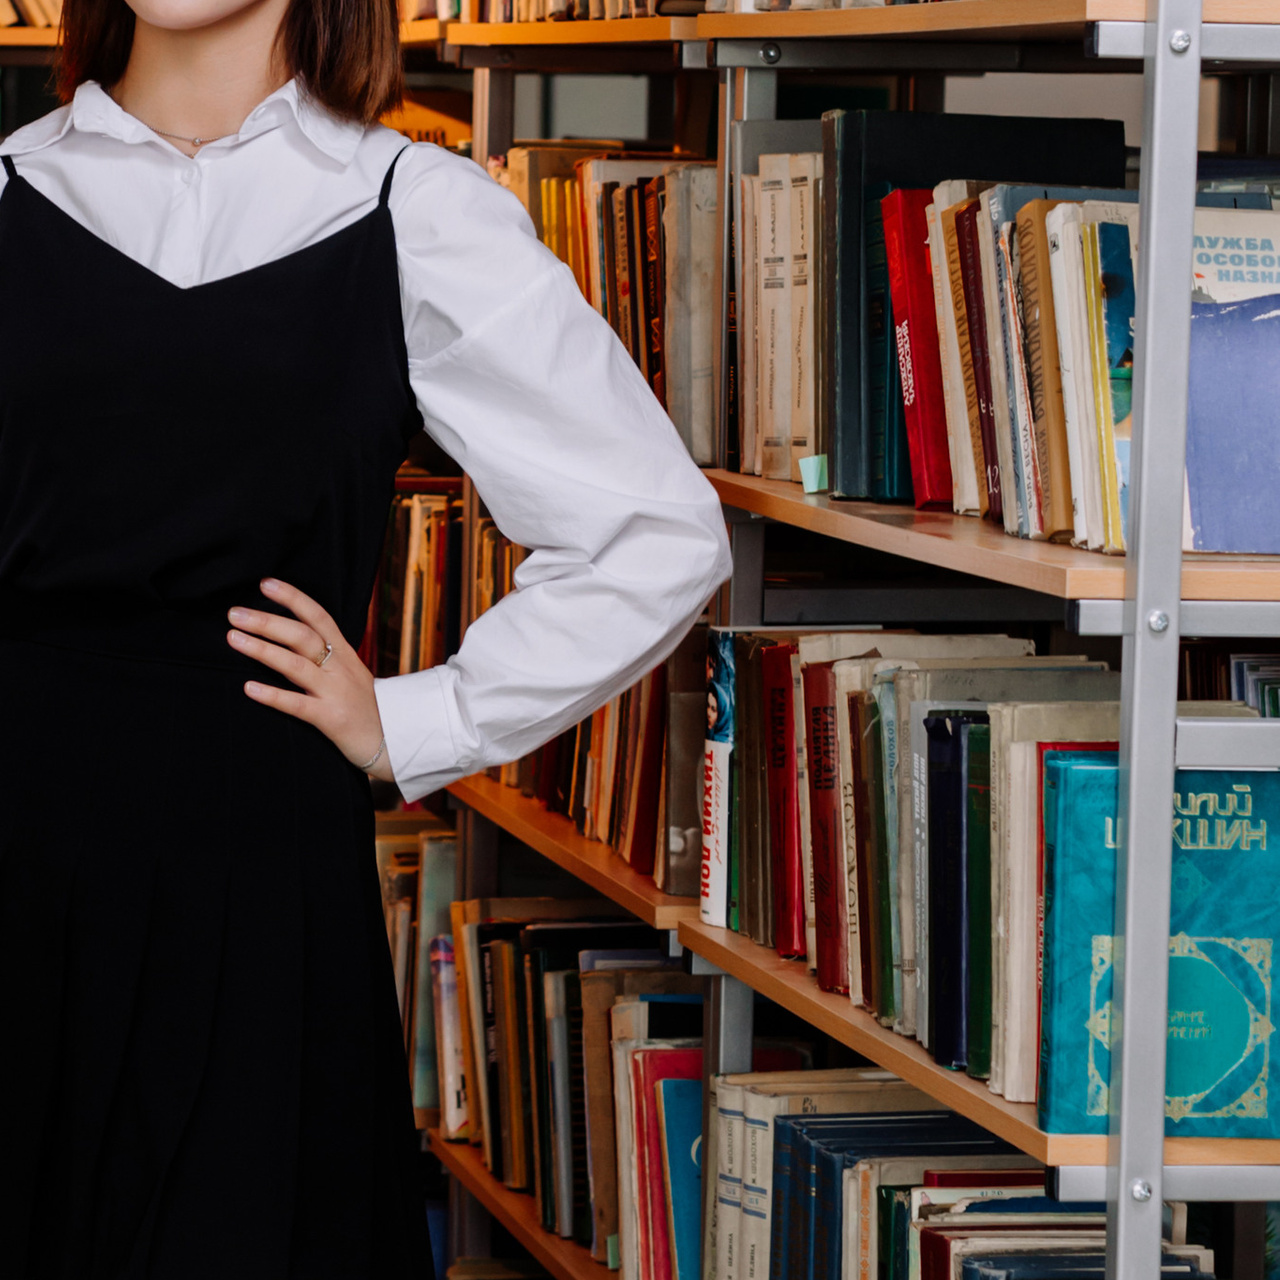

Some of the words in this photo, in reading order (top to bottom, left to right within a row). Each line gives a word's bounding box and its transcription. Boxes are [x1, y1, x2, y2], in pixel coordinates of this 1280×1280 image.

[1193, 235, 1275, 253] ЛУЖБА
[811, 706, 824, 791] ПОДНЯТАЯ
[823, 705, 837, 791] ЦЕЛИНА
[702, 749, 715, 836] ТИХИЙ
[1105, 816, 1267, 851] ШКШИН
[700, 843, 712, 899] ДОН
[843, 782, 858, 935] ШОЛОХОВ
